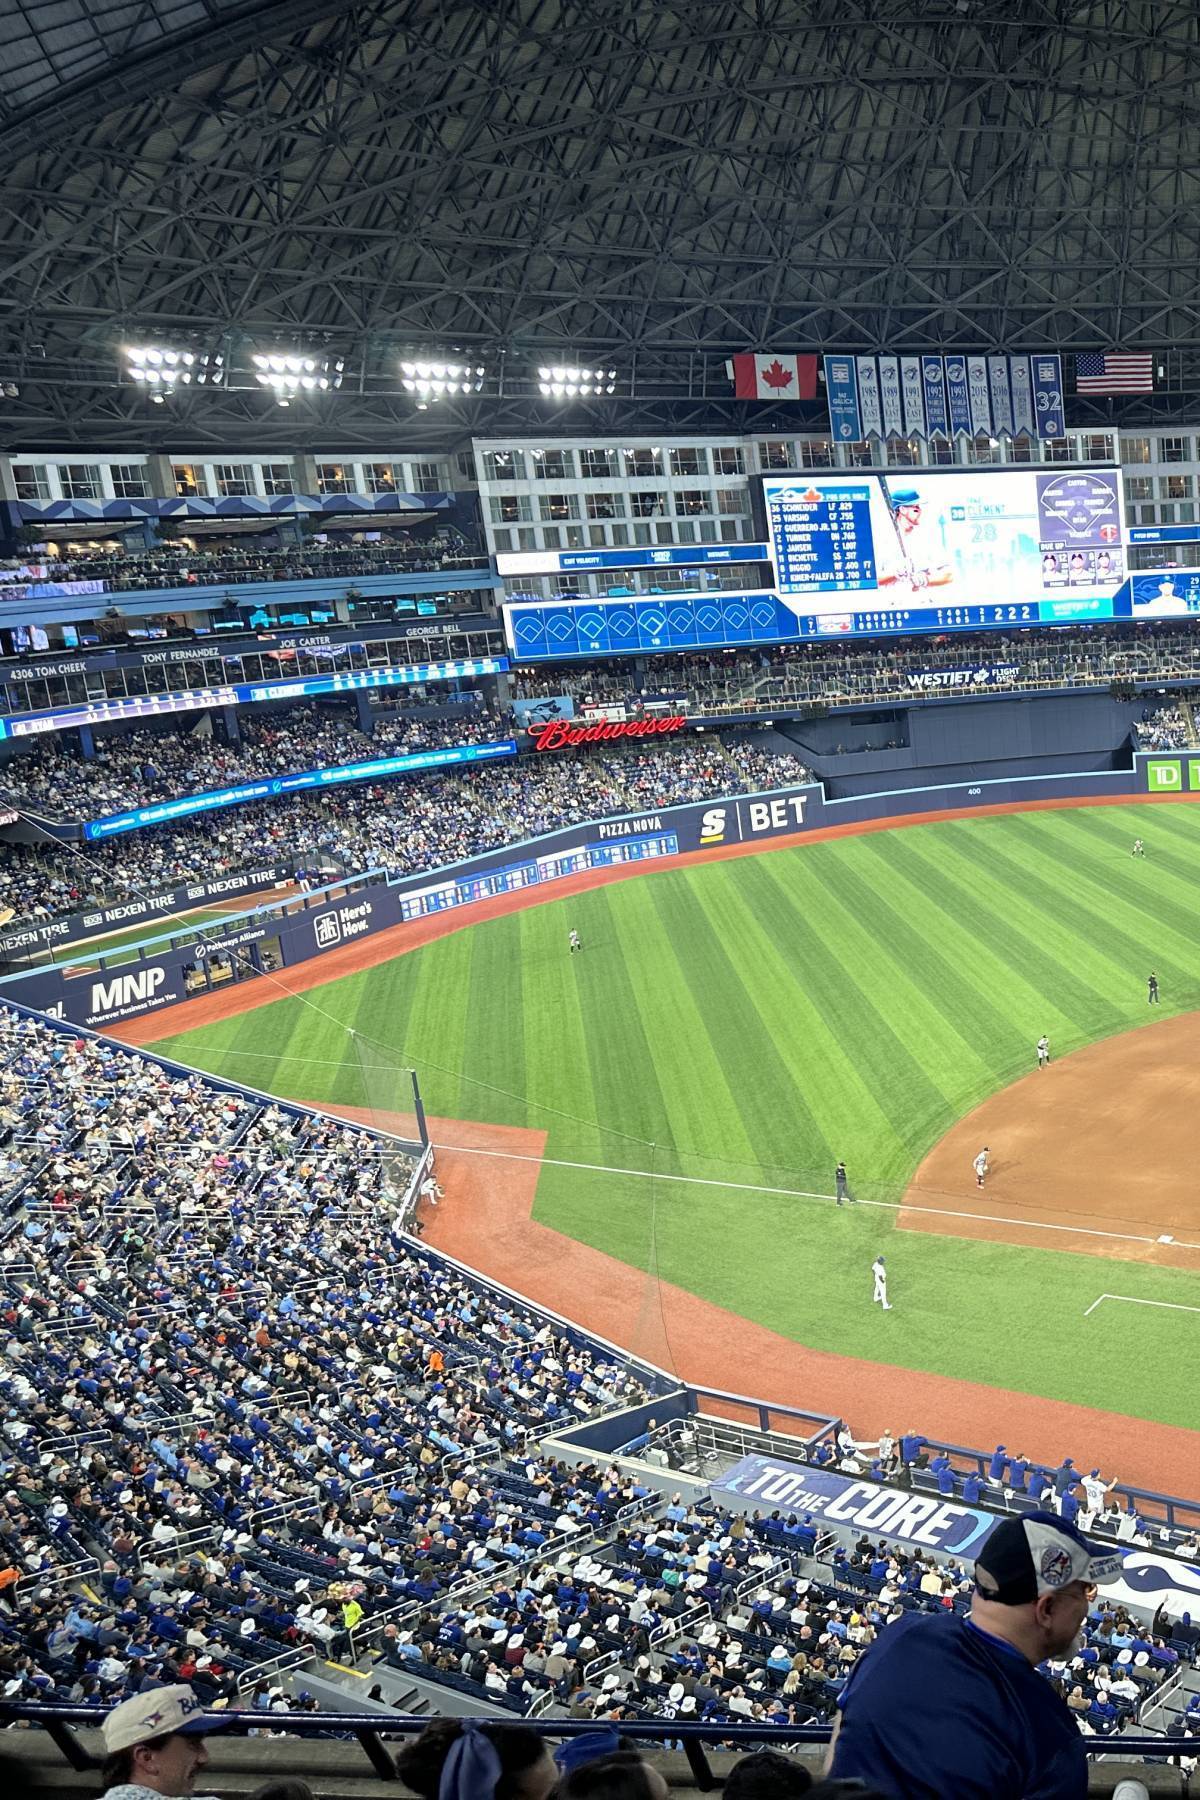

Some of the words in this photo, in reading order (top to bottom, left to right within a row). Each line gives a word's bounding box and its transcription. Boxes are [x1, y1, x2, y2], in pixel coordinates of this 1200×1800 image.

[861, 386, 876, 396] 1985
[883, 386, 898, 396] 1989
[905, 386, 920, 396] 1991
[927, 386, 942, 396] 1992
[950, 386, 965, 396] 1993
[971, 385, 988, 396] 2015
[1036, 391, 1062, 411] 32
[864, 408, 878, 417] EAST
[885, 408, 900, 417] EAST
[907, 408, 922, 417] EAST
[995, 607, 1003, 620] 2
[1008, 606, 1016, 619] 2
[1021, 605, 1030, 619] 2
[406, 625, 439, 636] GEORGE
[442, 624, 460, 633] BELL
[280, 638, 297, 648] JOE
[299, 636, 331, 646] CARTER
[142, 653, 167, 664] TONY
[170, 647, 219, 660] FERNANDEZ
[10, 667, 33, 680] 4306
[35, 664, 57, 677] TOM
[58, 661, 87, 674] CHEEK
[907, 671, 972, 687] WESTJET
[992, 667, 1019, 676] FLIGHT
[528, 715, 687, 750] Budweiser
[1152, 766, 1178, 785] TD
[967, 788, 981, 796] 400
[750, 796, 807, 832] BET
[599, 821, 631, 838] PIZZA
[633, 817, 662, 834] NOVA
[207, 875, 247, 895] NEXEN
[249, 868, 277, 885] TIRE
[105, 901, 146, 922] NEXEN
[148, 894, 176, 912] TIRE
[340, 901, 372, 923] Here's
[342, 918, 369, 937] How.
[207, 937, 239, 953] Pathways
[239, 929, 266, 943] Alliance
[92, 967, 165, 1013] MNP
[86, 1011, 119, 1025] Wherever
[120, 1003, 147, 1017] Business
[147, 998, 164, 1010] Takes
[165, 994, 177, 1003] You
[1087, 1489, 1097, 1499] 20
[742, 1466, 805, 1502] TO
[784, 1488, 831, 1518] THE
[823, 1481, 967, 1545] CORE
